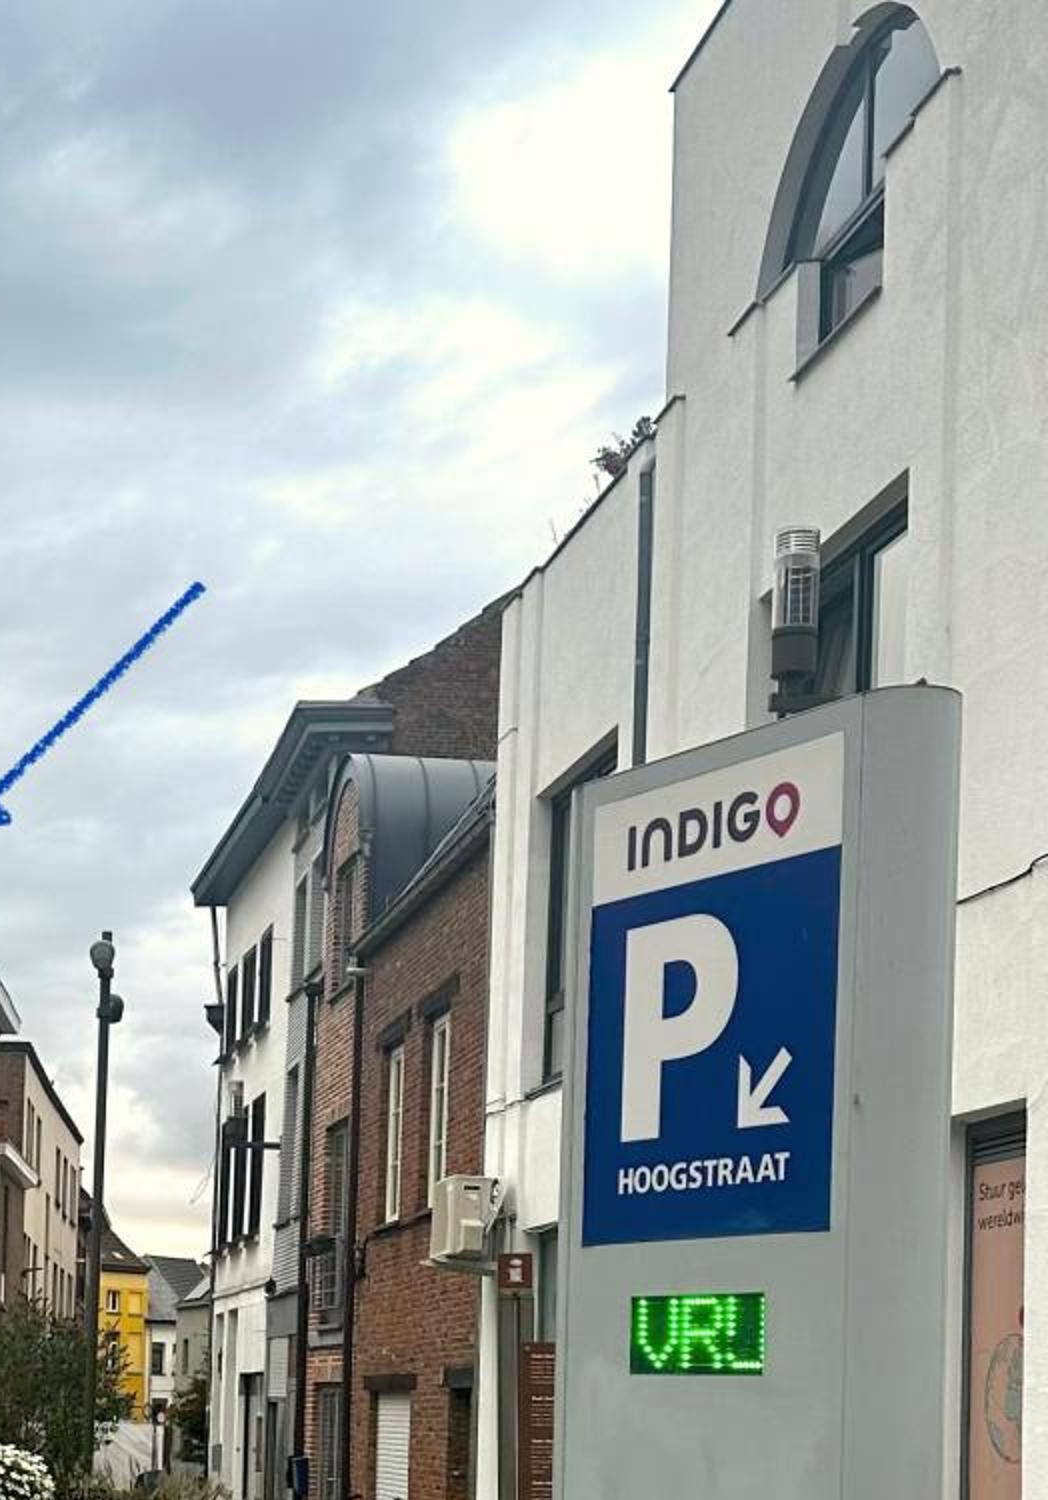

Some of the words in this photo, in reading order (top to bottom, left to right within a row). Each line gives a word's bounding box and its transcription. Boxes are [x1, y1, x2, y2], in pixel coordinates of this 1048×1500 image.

[627, 781, 801, 872] INDIGO
[620, 913, 739, 1143] P
[617, 1151, 791, 1195] HOOGSTRAAT
